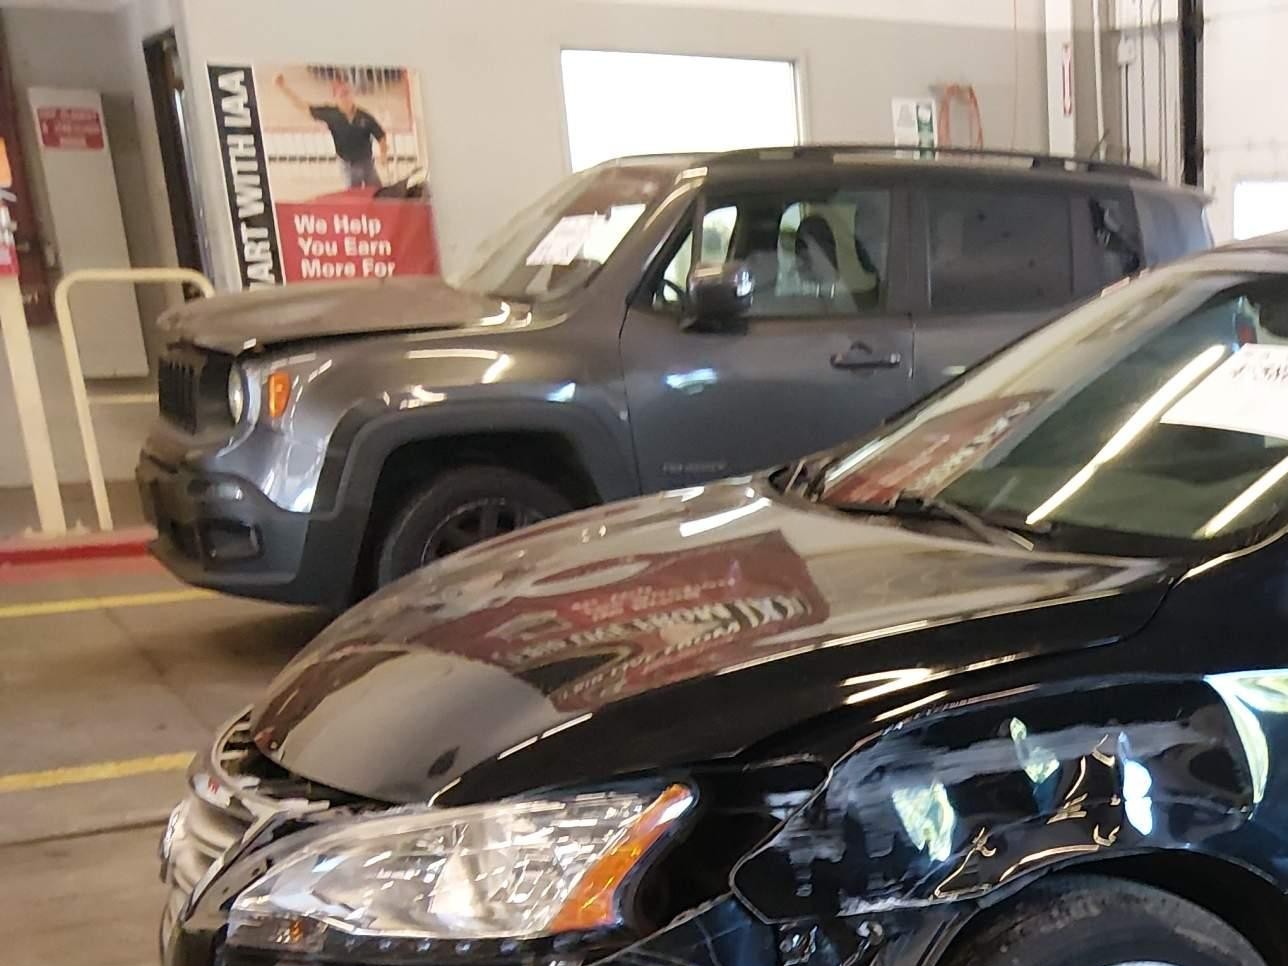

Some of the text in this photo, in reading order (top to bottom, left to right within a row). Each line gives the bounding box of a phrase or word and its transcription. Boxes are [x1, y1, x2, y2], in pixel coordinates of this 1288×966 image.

[217, 70, 275, 289] ART WITH IAA
[294, 213, 381, 237] We Help
[298, 237, 392, 256] You Earn
[301, 258, 395, 278] More For
